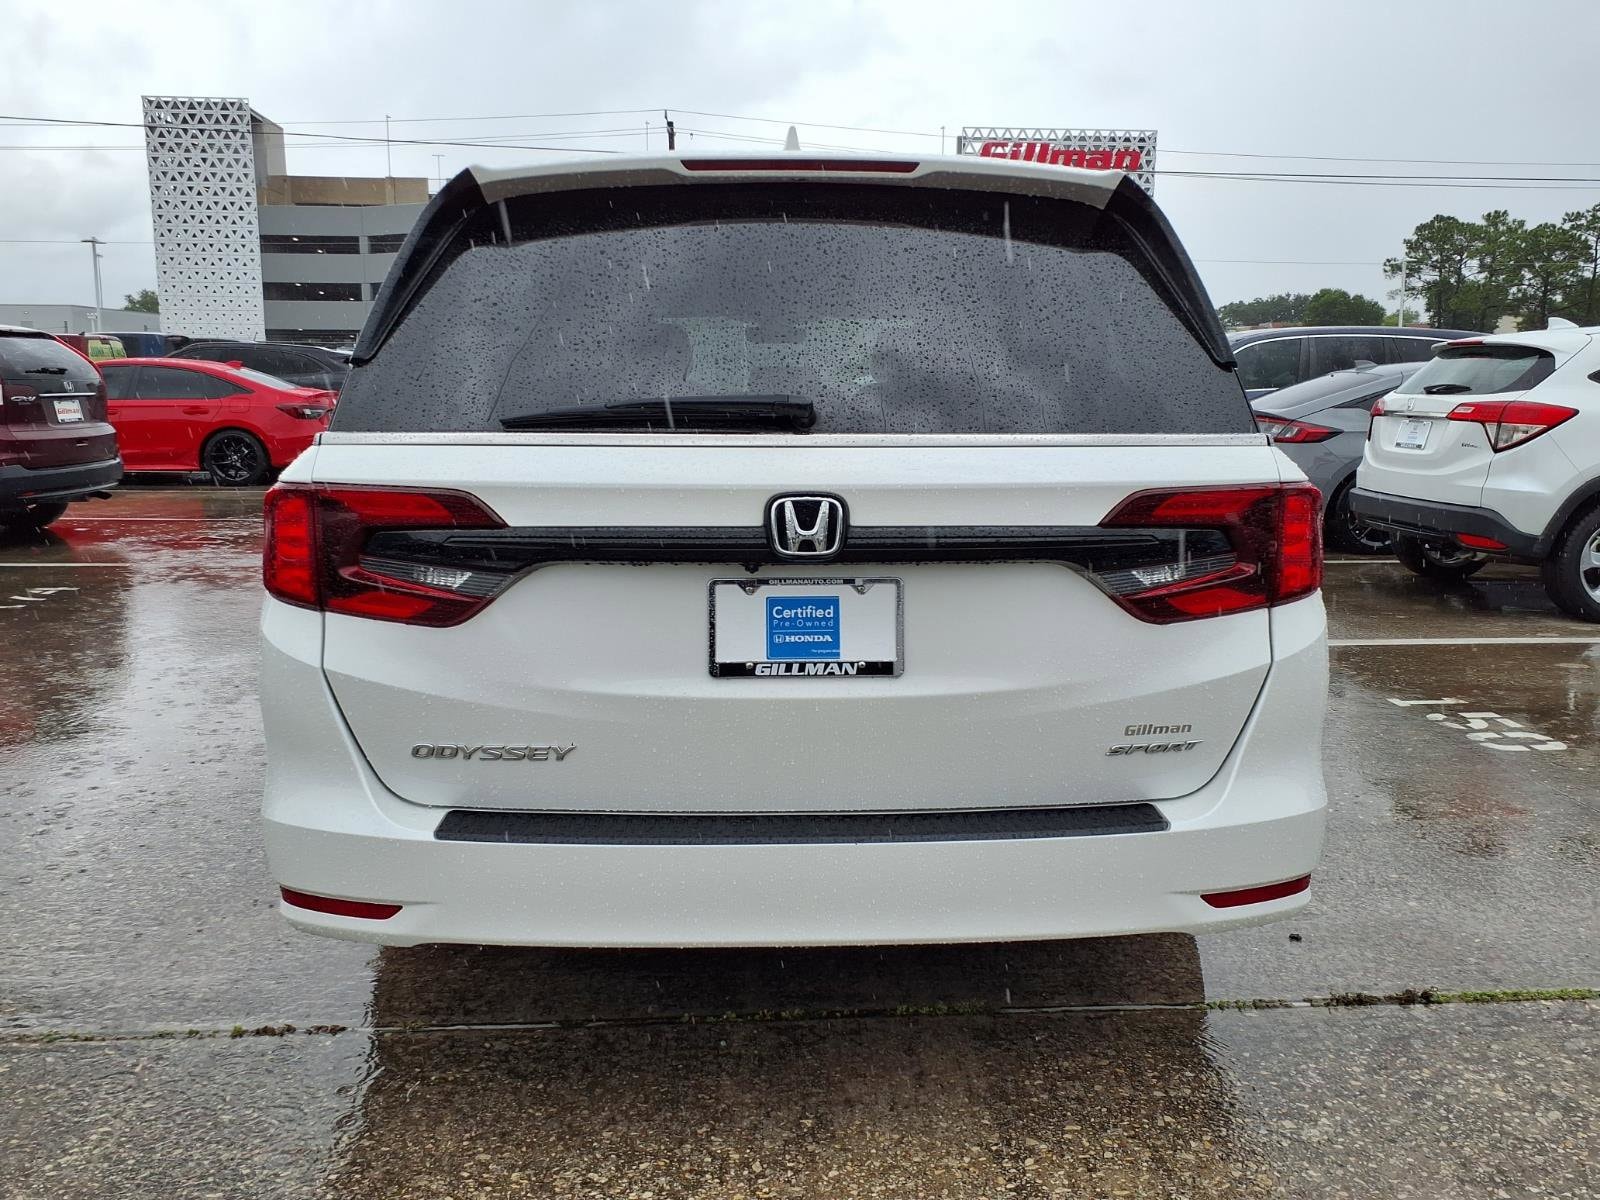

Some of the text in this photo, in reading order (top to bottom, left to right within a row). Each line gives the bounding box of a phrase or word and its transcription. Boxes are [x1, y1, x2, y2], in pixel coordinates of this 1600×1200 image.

[772, 605, 834, 619] Certified
[773, 619, 834, 627] Pre-Owned
[784, 634, 833, 643] HONDA
[754, 662, 858, 677] GILLMAN
[1124, 724, 1192, 737] Gillman
[411, 743, 577, 762] ODYSSEY
[1104, 739, 1205, 757] SPORT
